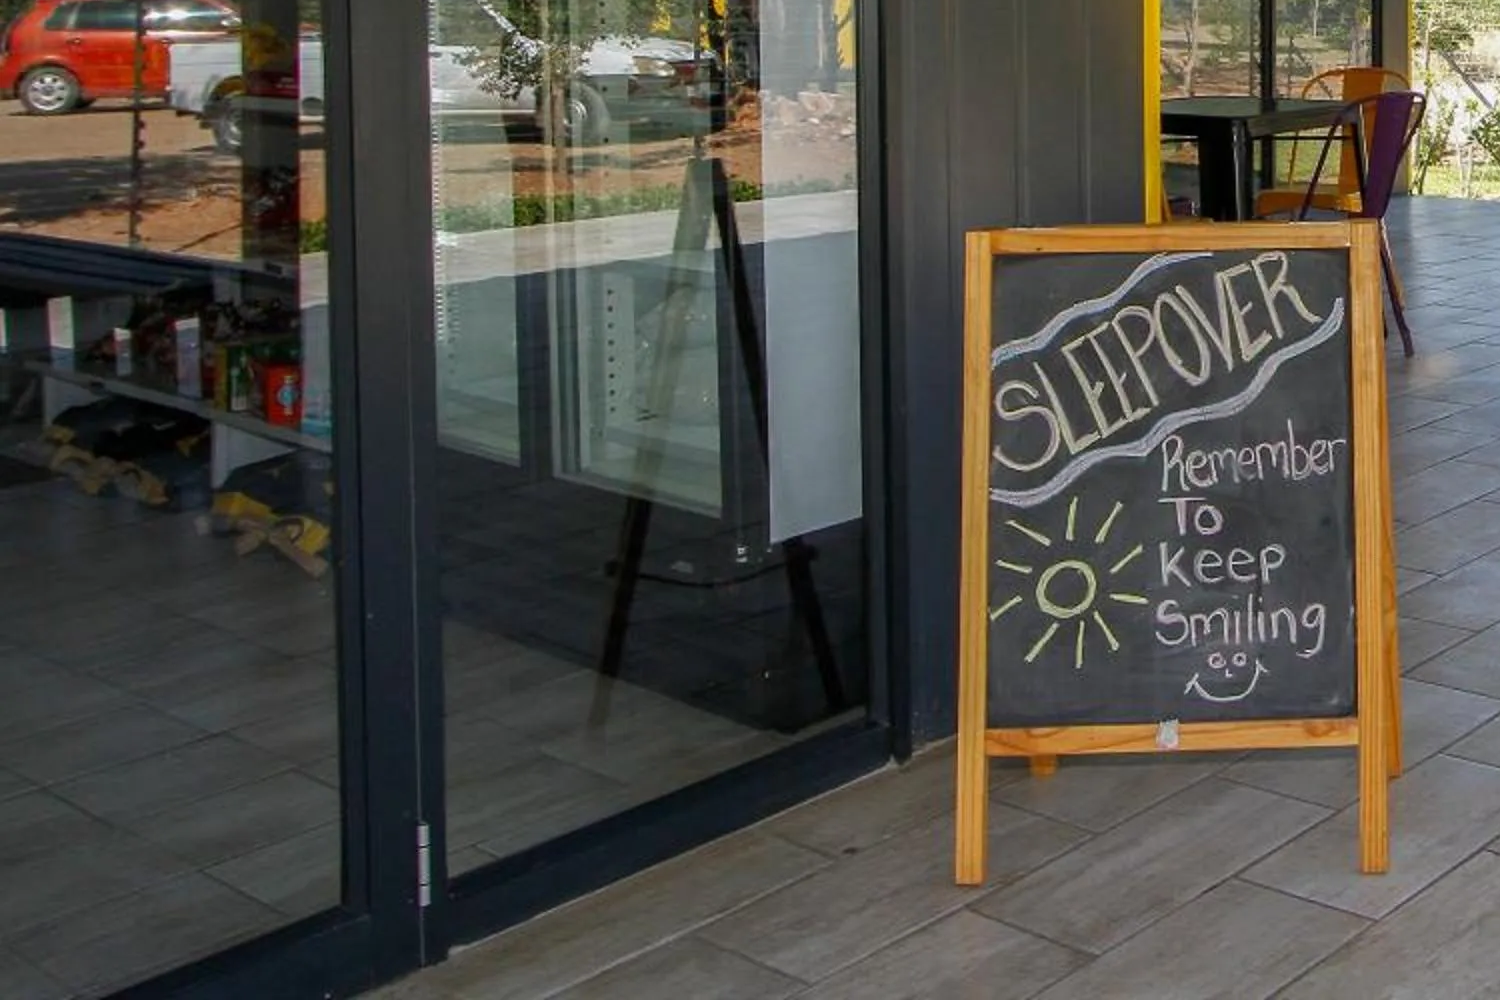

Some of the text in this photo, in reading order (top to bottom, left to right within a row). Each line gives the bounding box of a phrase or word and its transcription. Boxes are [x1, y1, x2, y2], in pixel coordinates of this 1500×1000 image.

[992, 251, 1322, 472] SLEEPOVER
[1161, 418, 1346, 493] Remember
[1158, 498, 1224, 536] To
[1159, 541, 1286, 587] Keep
[1155, 597, 1327, 659] Smiling
